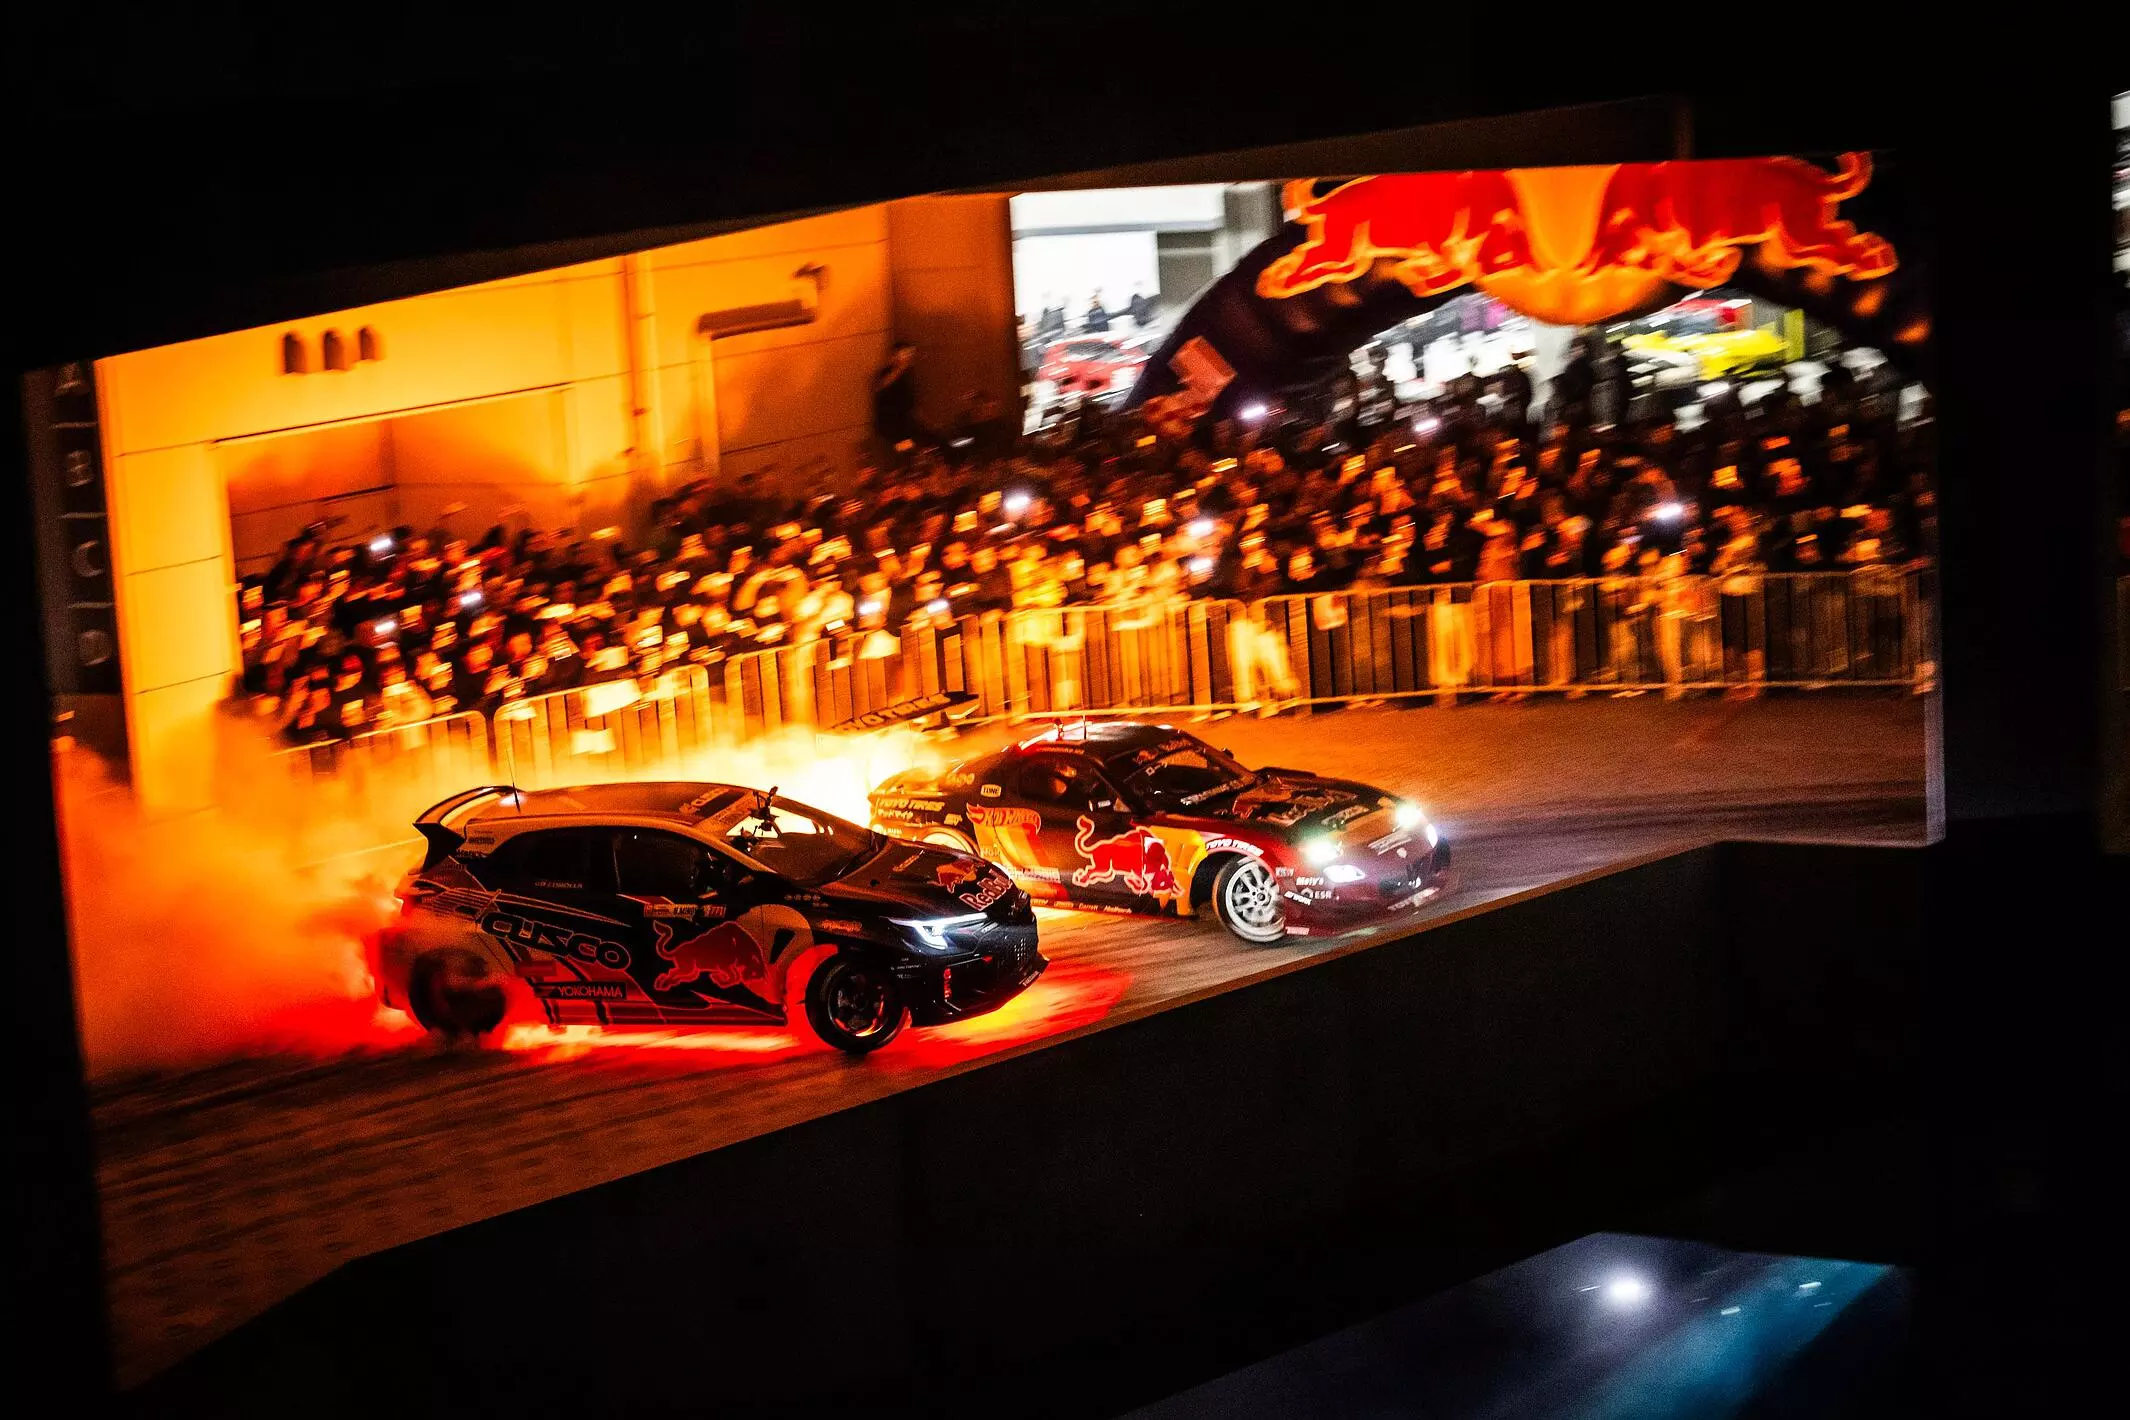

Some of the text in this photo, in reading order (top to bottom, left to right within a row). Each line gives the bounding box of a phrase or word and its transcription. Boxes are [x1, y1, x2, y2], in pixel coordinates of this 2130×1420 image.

[73, 540, 106, 578] C
[479, 911, 632, 970] CUSCO
[558, 985, 623, 999] YOKOHAMA
